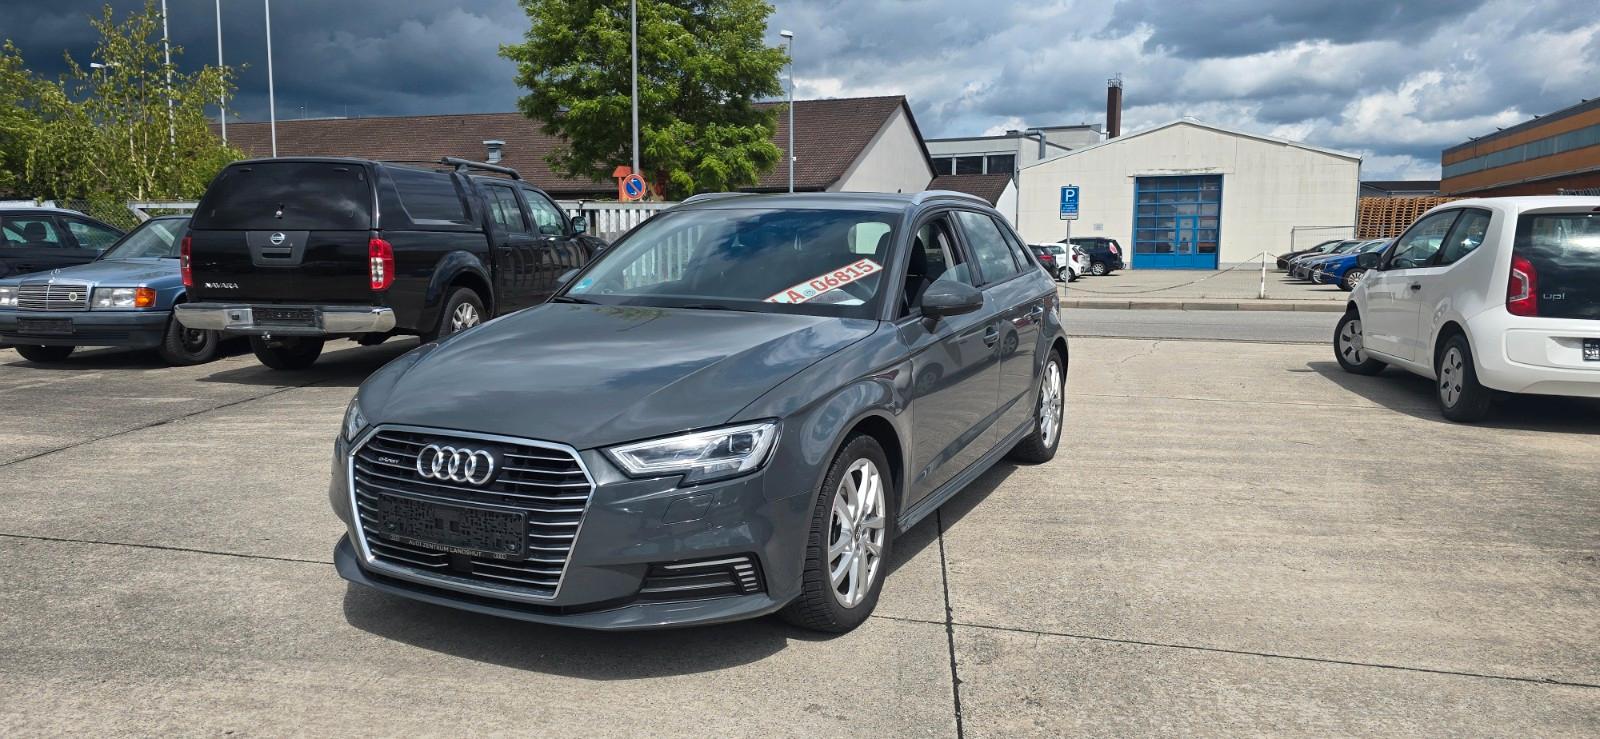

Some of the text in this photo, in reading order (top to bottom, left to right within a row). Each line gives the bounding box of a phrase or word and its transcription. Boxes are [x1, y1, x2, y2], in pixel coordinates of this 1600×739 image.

[1065, 189, 1075, 202] P
[771, 262, 874, 304] A 06815
[1543, 292, 1565, 301] up!
[424, 542, 449, 553] ZENTRUM
[449, 548, 482, 557] LANDSHUT
